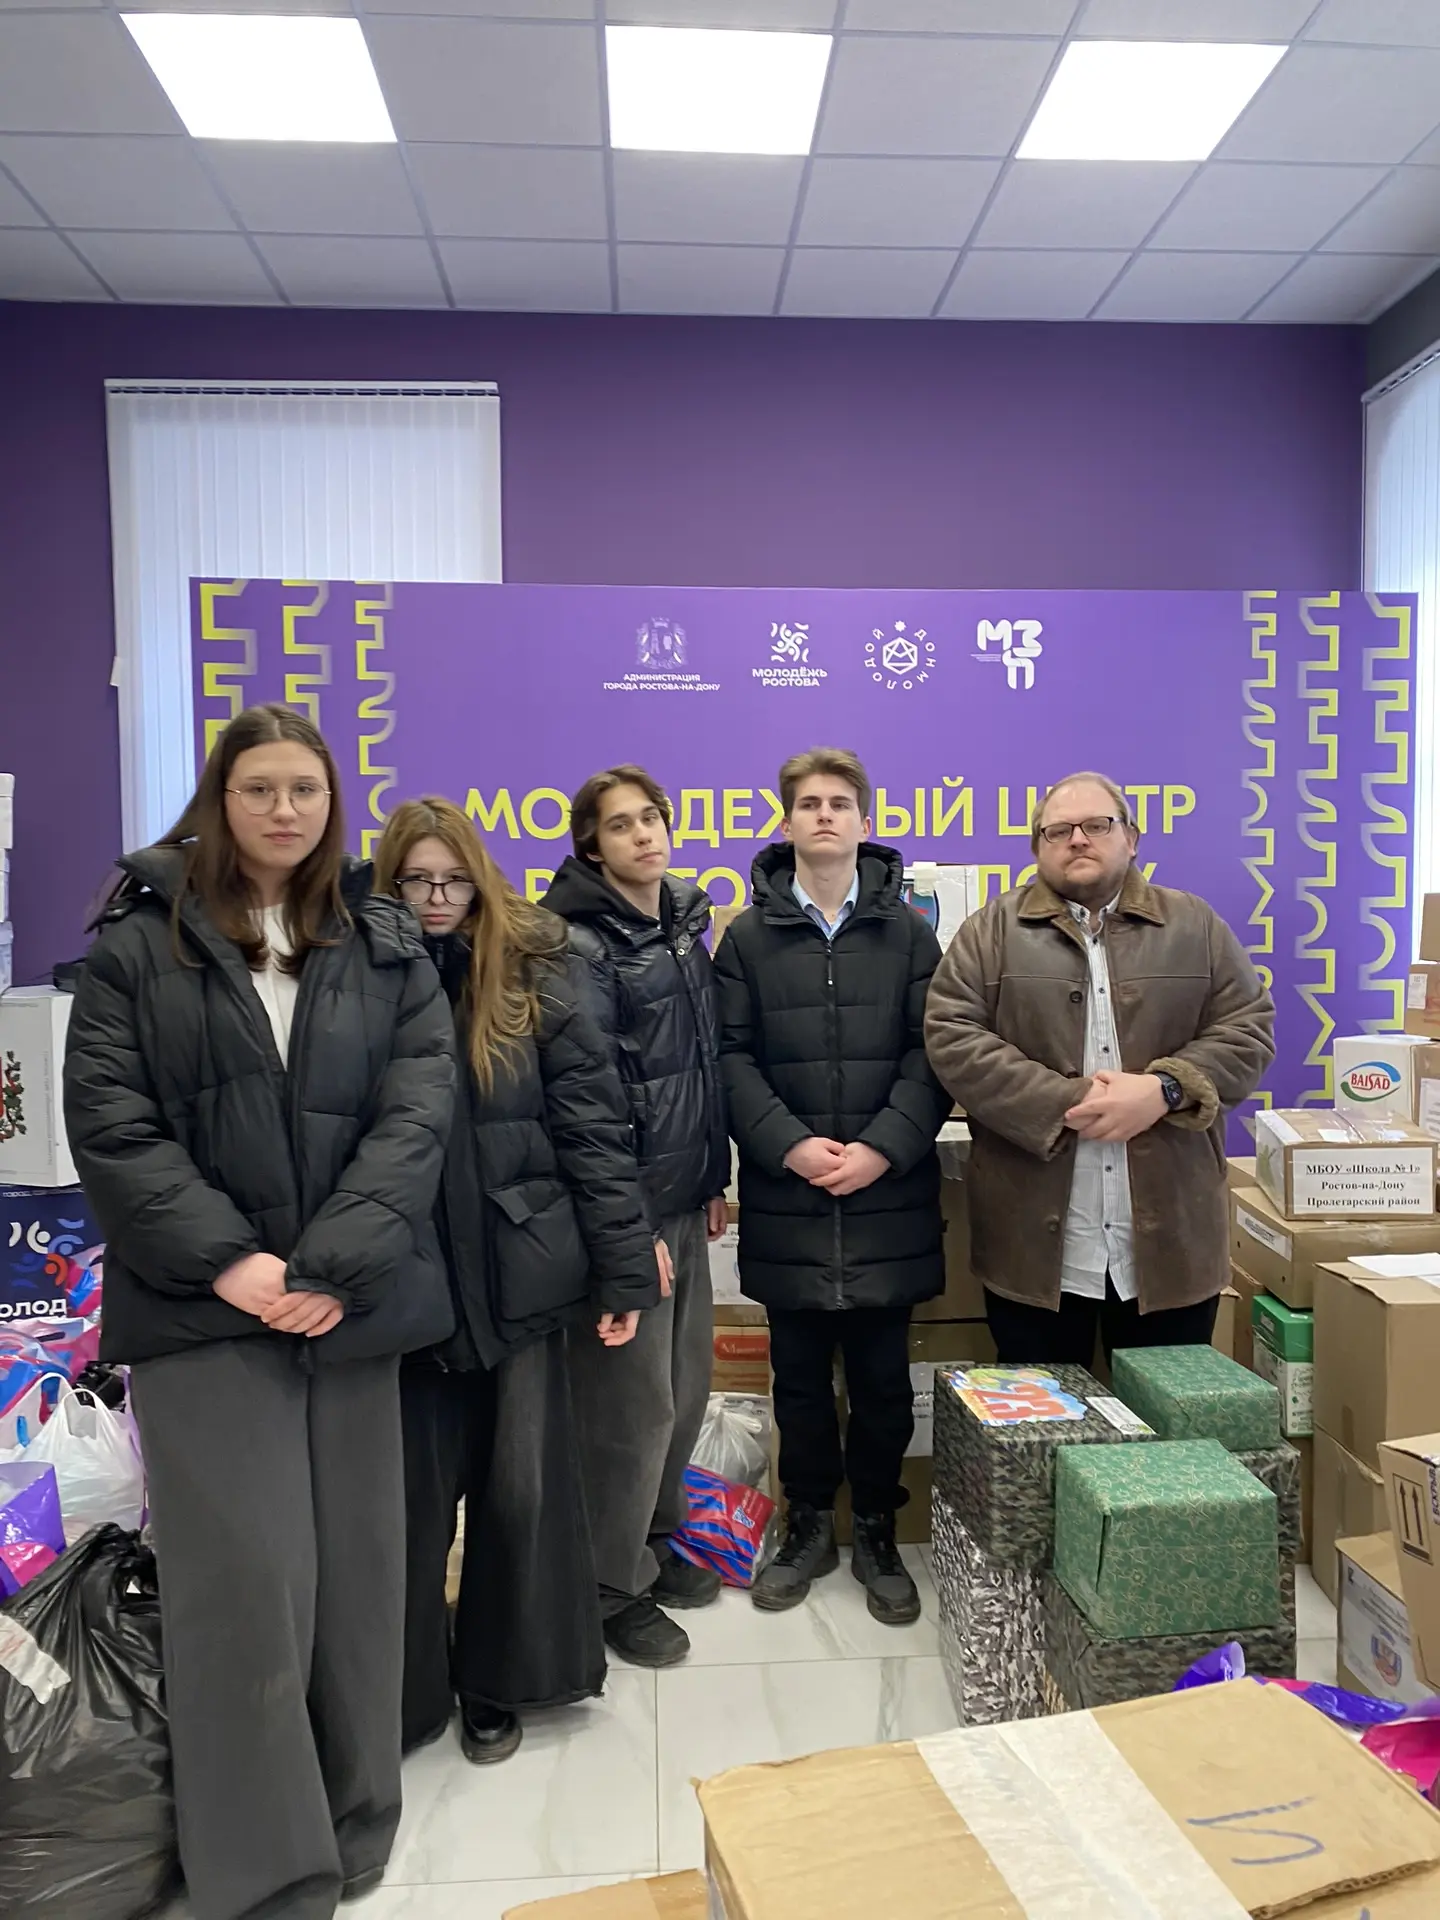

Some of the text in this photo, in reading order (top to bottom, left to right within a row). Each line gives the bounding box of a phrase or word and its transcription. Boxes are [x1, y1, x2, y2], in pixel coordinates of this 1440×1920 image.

[623, 673, 701, 682] АДМИНИСТРАЦИЯ
[752, 667, 828, 678] МОЛОДЁЖЬ
[603, 682, 721, 692] ГОРОДА РОСТОВА-НА-ДОНУ
[762, 678, 820, 687] РОСТОВА
[998, 784, 1197, 837] ЦТР
[1351, 1073, 1391, 1091] BAISAD
[1306, 1164, 1343, 1174] МБОУ
[1346, 1164, 1391, 1174] «Школа
[1321, 1180, 1406, 1191] Ростов-на-Дону
[1307, 1197, 1420, 1208] Пролетарский район
[970, 1382, 1067, 1421] 23
